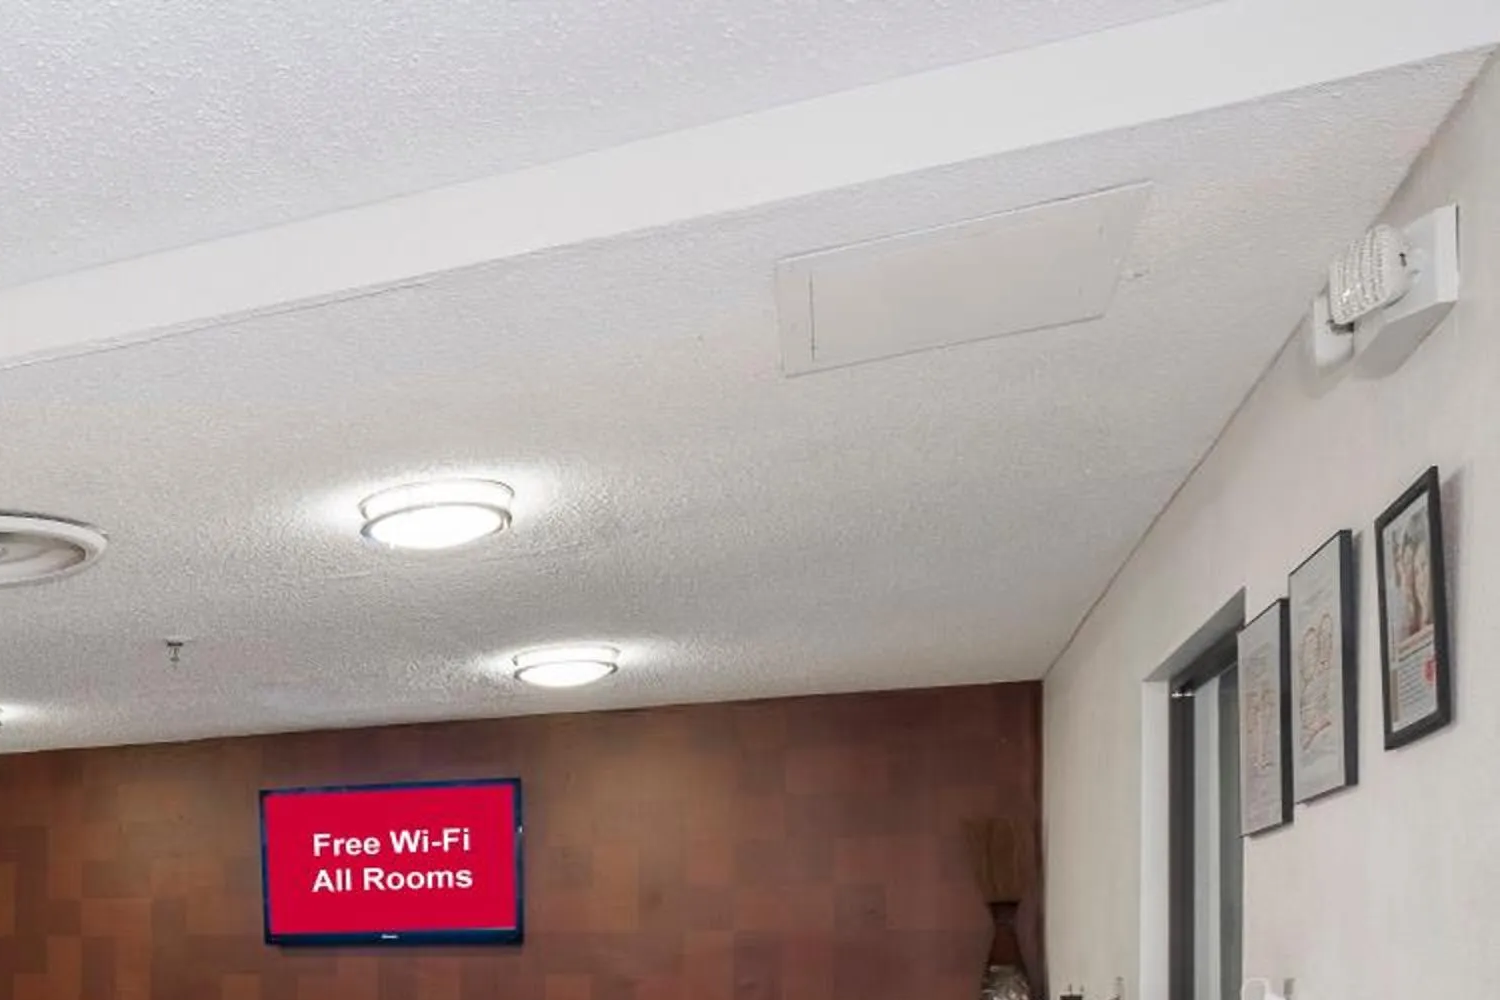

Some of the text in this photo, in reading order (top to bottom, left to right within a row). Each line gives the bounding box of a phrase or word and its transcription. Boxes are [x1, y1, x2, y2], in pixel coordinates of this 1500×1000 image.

[312, 828, 471, 857] Free Wi-Fi
[311, 867, 473, 893] All Rooms
